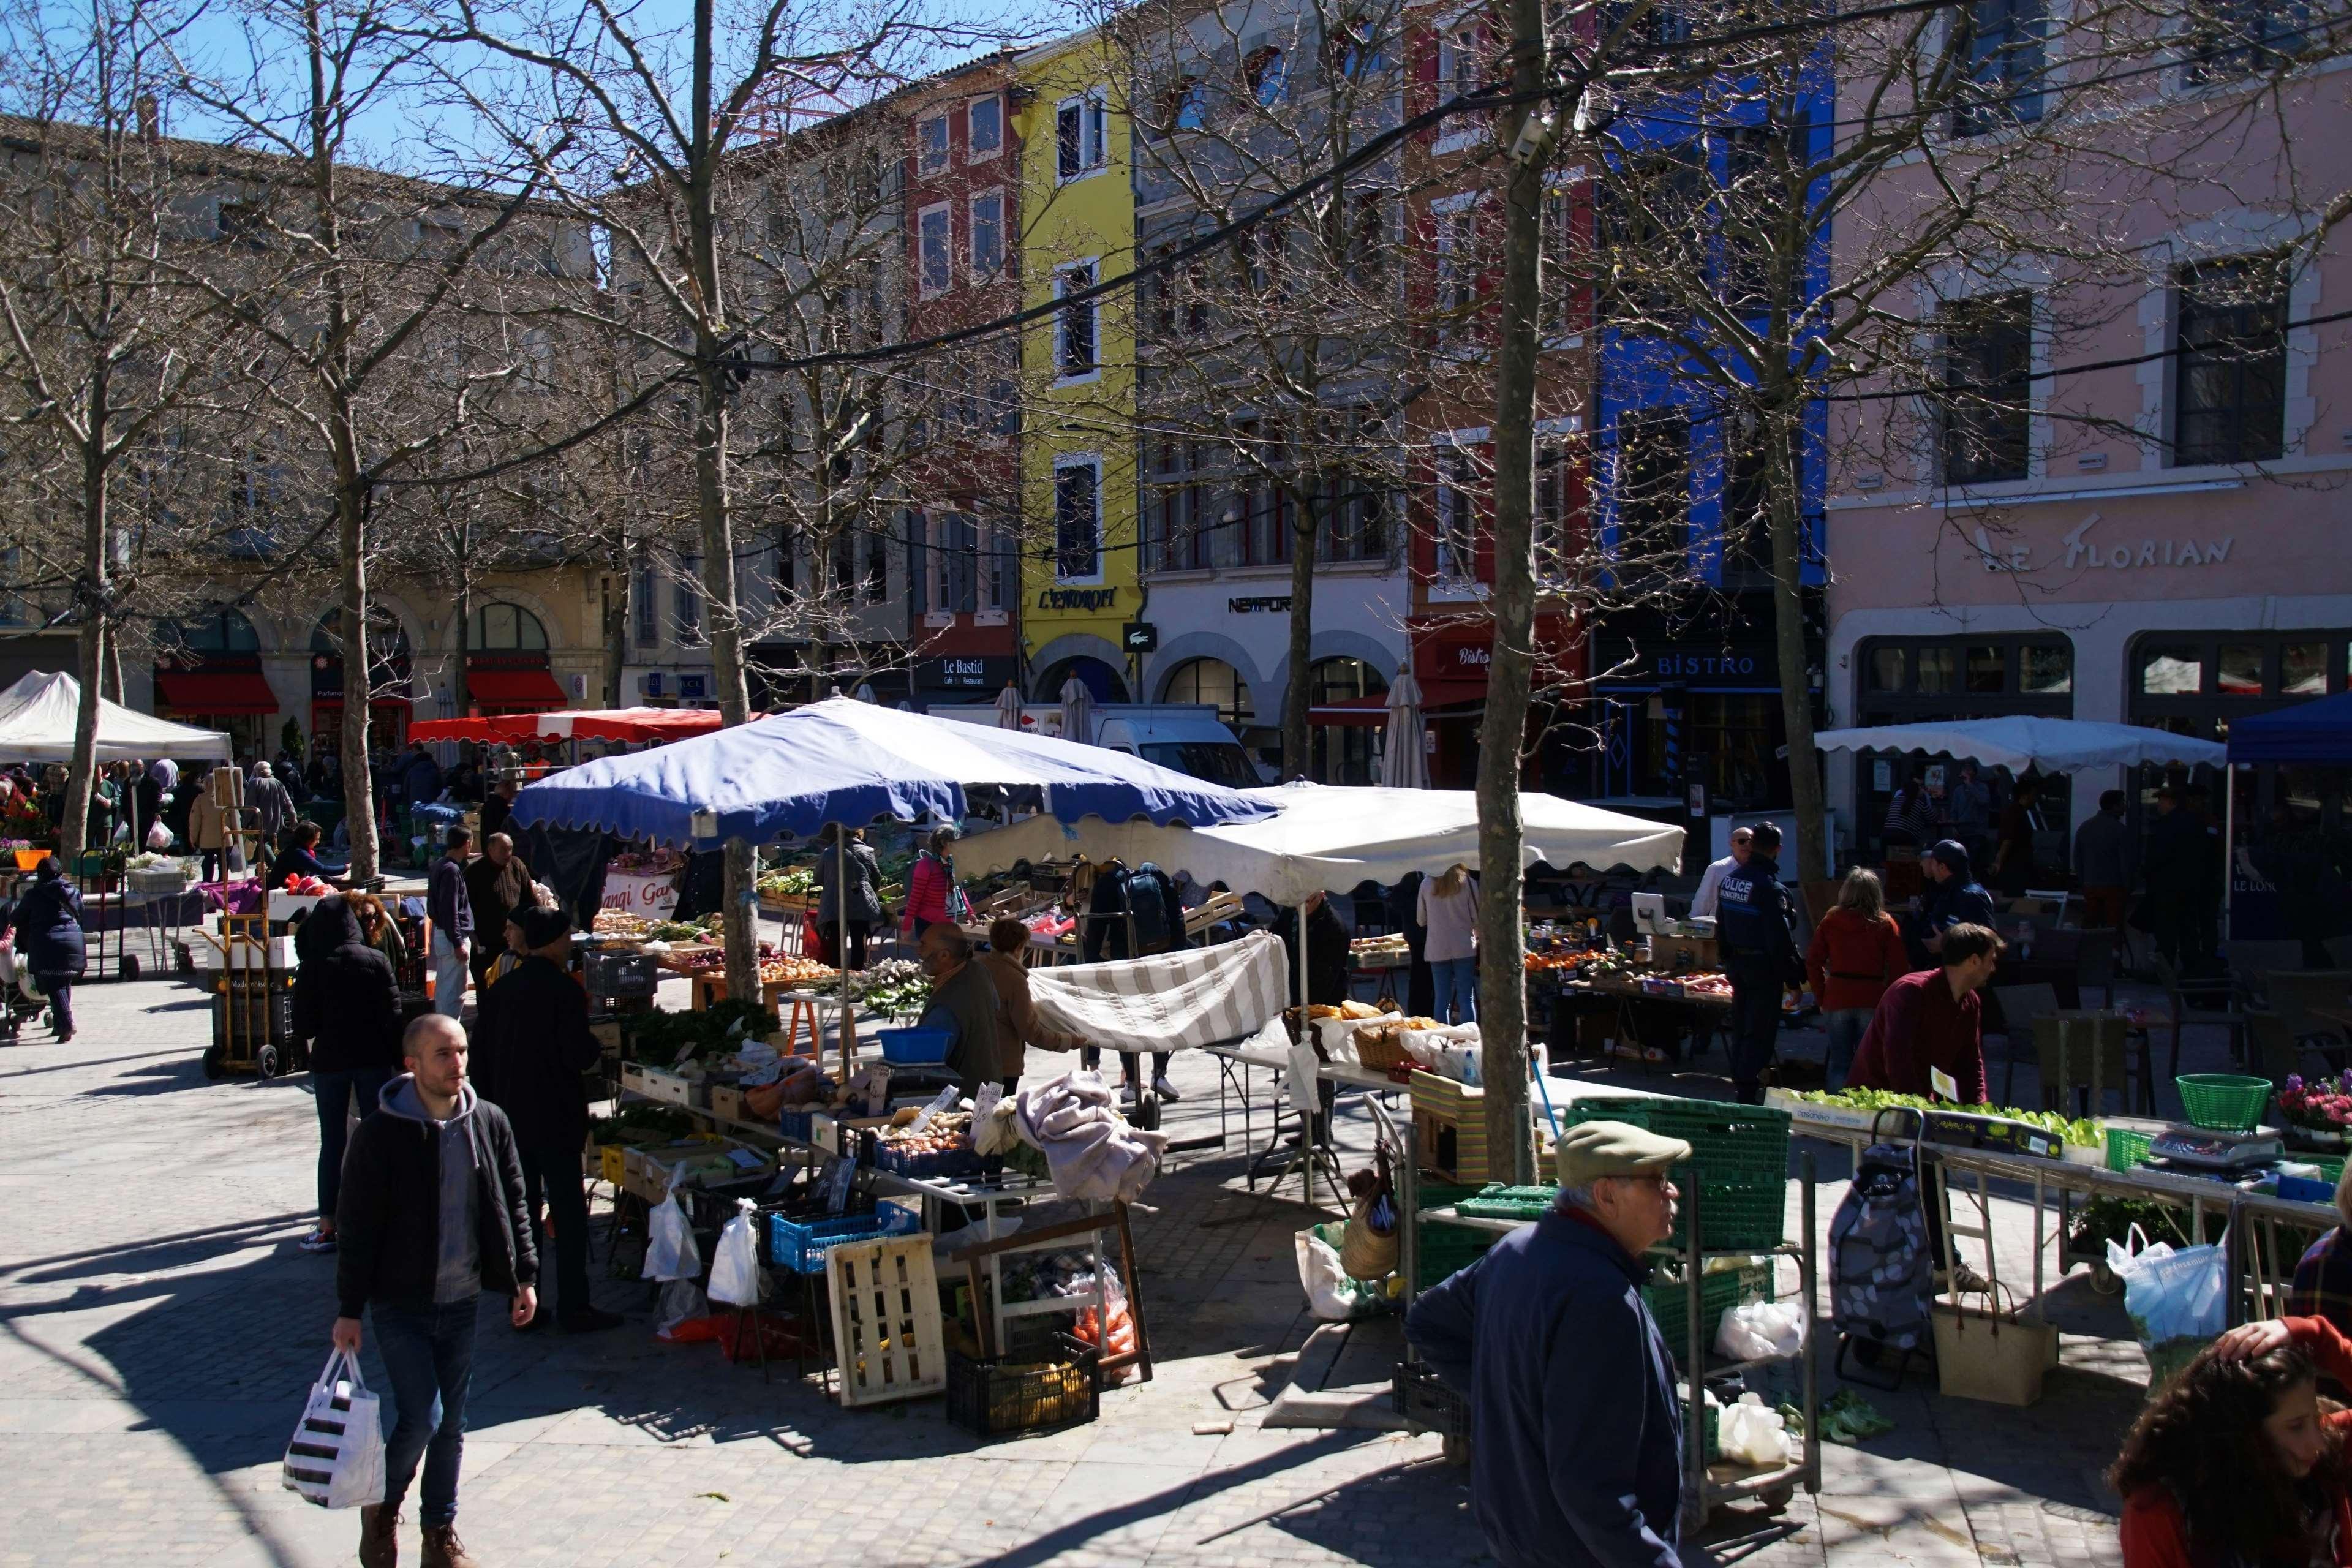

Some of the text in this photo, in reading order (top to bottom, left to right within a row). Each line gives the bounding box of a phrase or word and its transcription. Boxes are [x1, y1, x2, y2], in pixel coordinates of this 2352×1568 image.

[2063, 513, 2233, 569] FLORIAN
[1228, 596, 1292, 613] NEWPOR
[1458, 647, 1490, 665] Bistro
[944, 658, 983, 674] Le Bastid
[1721, 877, 1752, 894] POLICE
[2234, 880, 2245, 892] LE
[1720, 890, 1749, 902] MUNICIPALE
